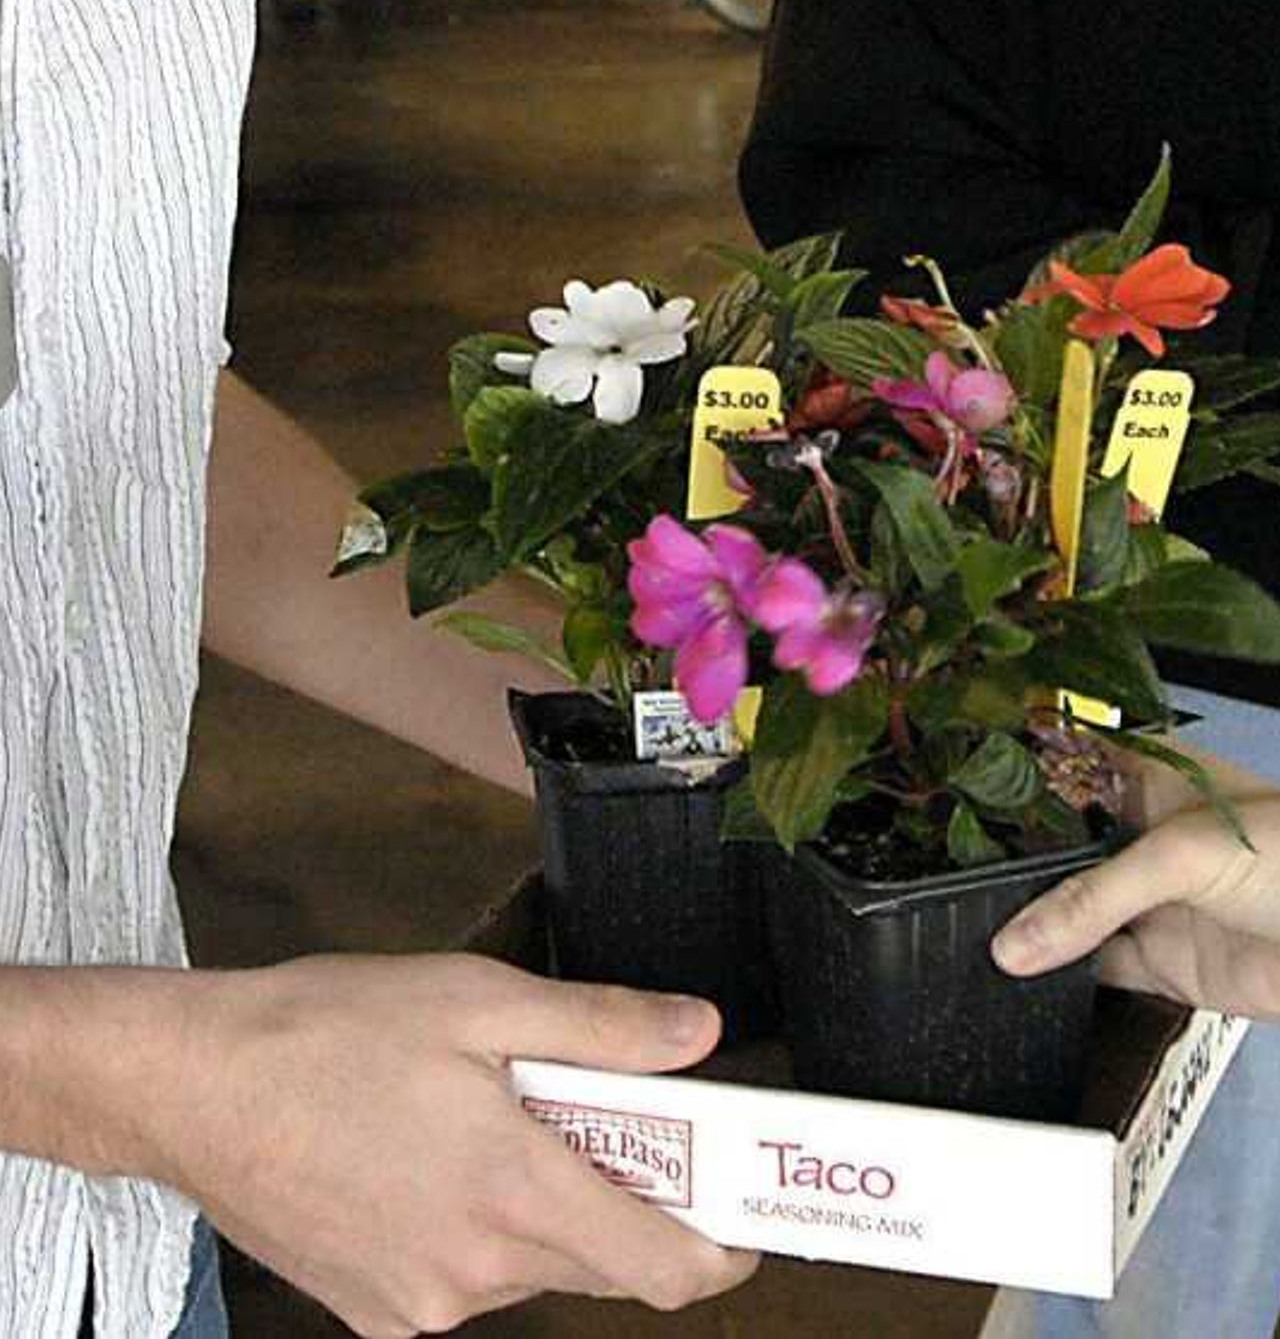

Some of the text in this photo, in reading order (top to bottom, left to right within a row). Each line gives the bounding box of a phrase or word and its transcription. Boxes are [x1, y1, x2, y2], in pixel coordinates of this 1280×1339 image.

[704, 390, 770, 410] $3.00
[1123, 422, 1169, 439] Each
[757, 1139, 895, 1200] Taco
[740, 1196, 872, 1234] SEASONING
